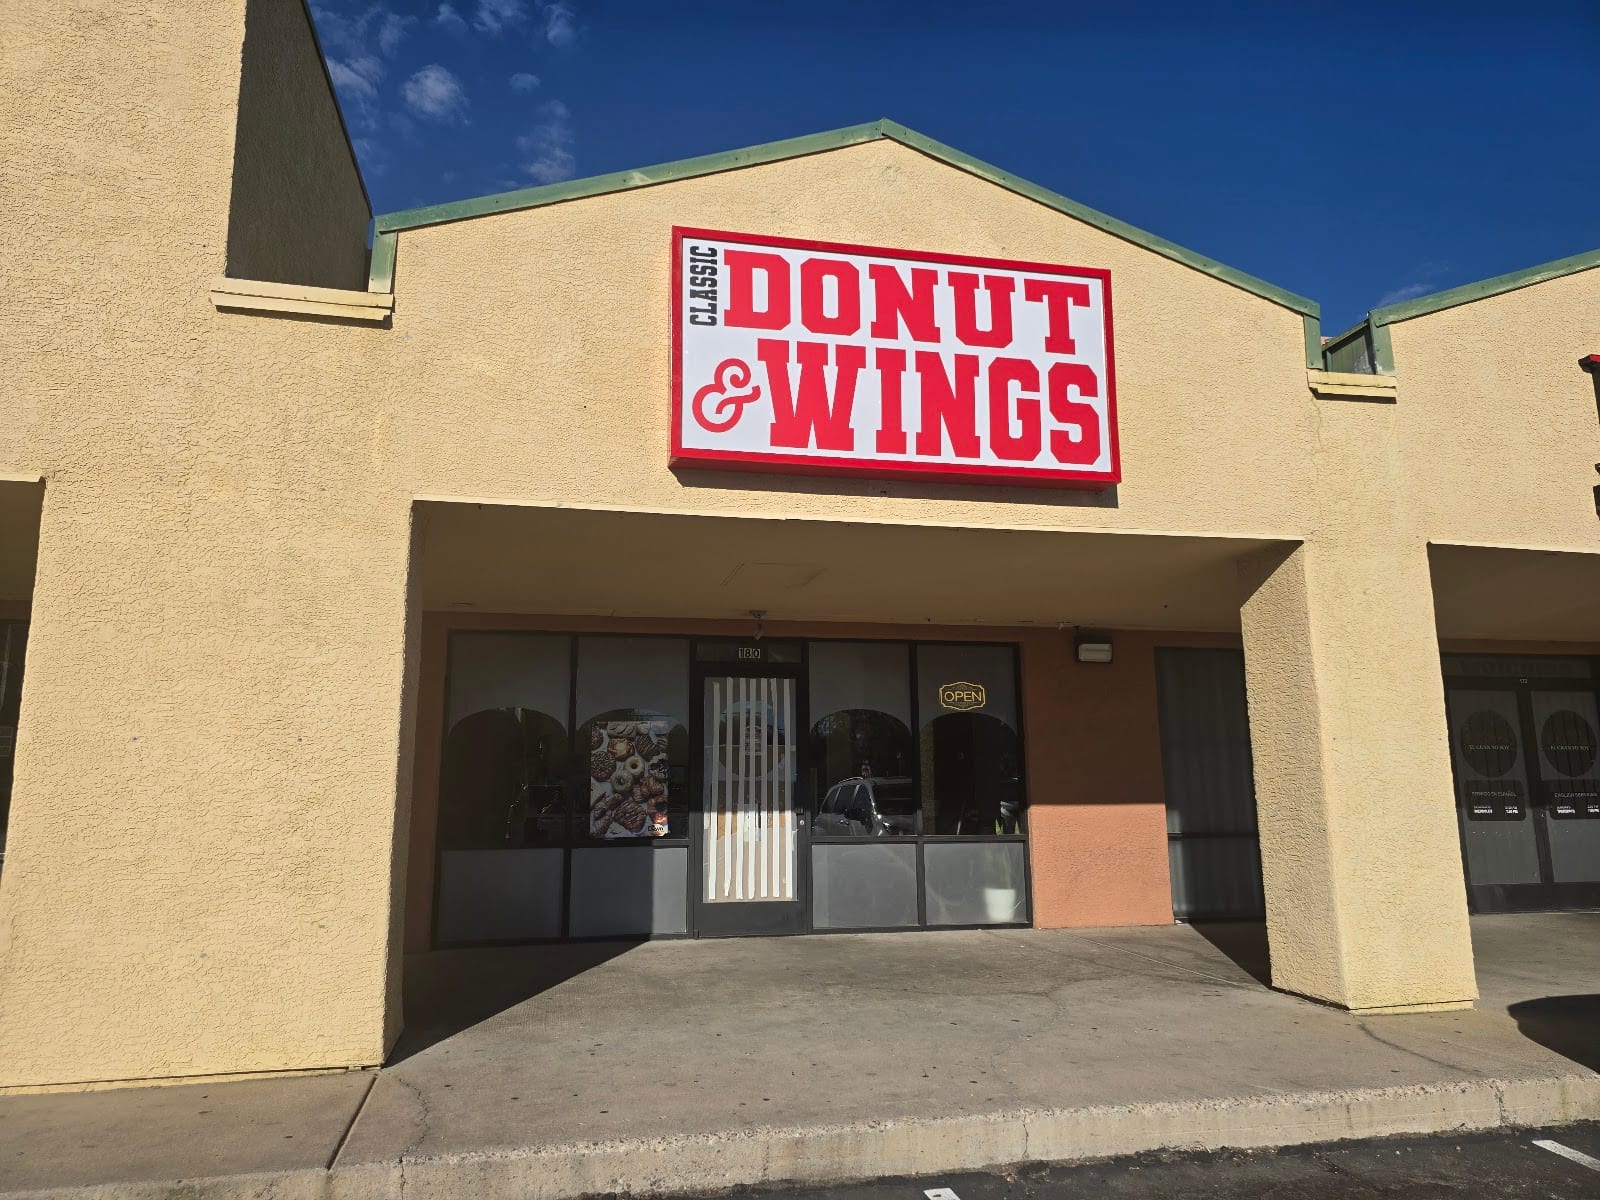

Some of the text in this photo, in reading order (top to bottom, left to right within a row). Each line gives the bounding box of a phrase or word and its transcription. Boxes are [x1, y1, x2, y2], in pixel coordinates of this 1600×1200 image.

[689, 246, 718, 326] CLASSIC
[723, 248, 1091, 355] DONUT
[692, 338, 1101, 466] & WINGS
[739, 648, 760, 658] 180
[944, 691, 982, 702] OPEN
